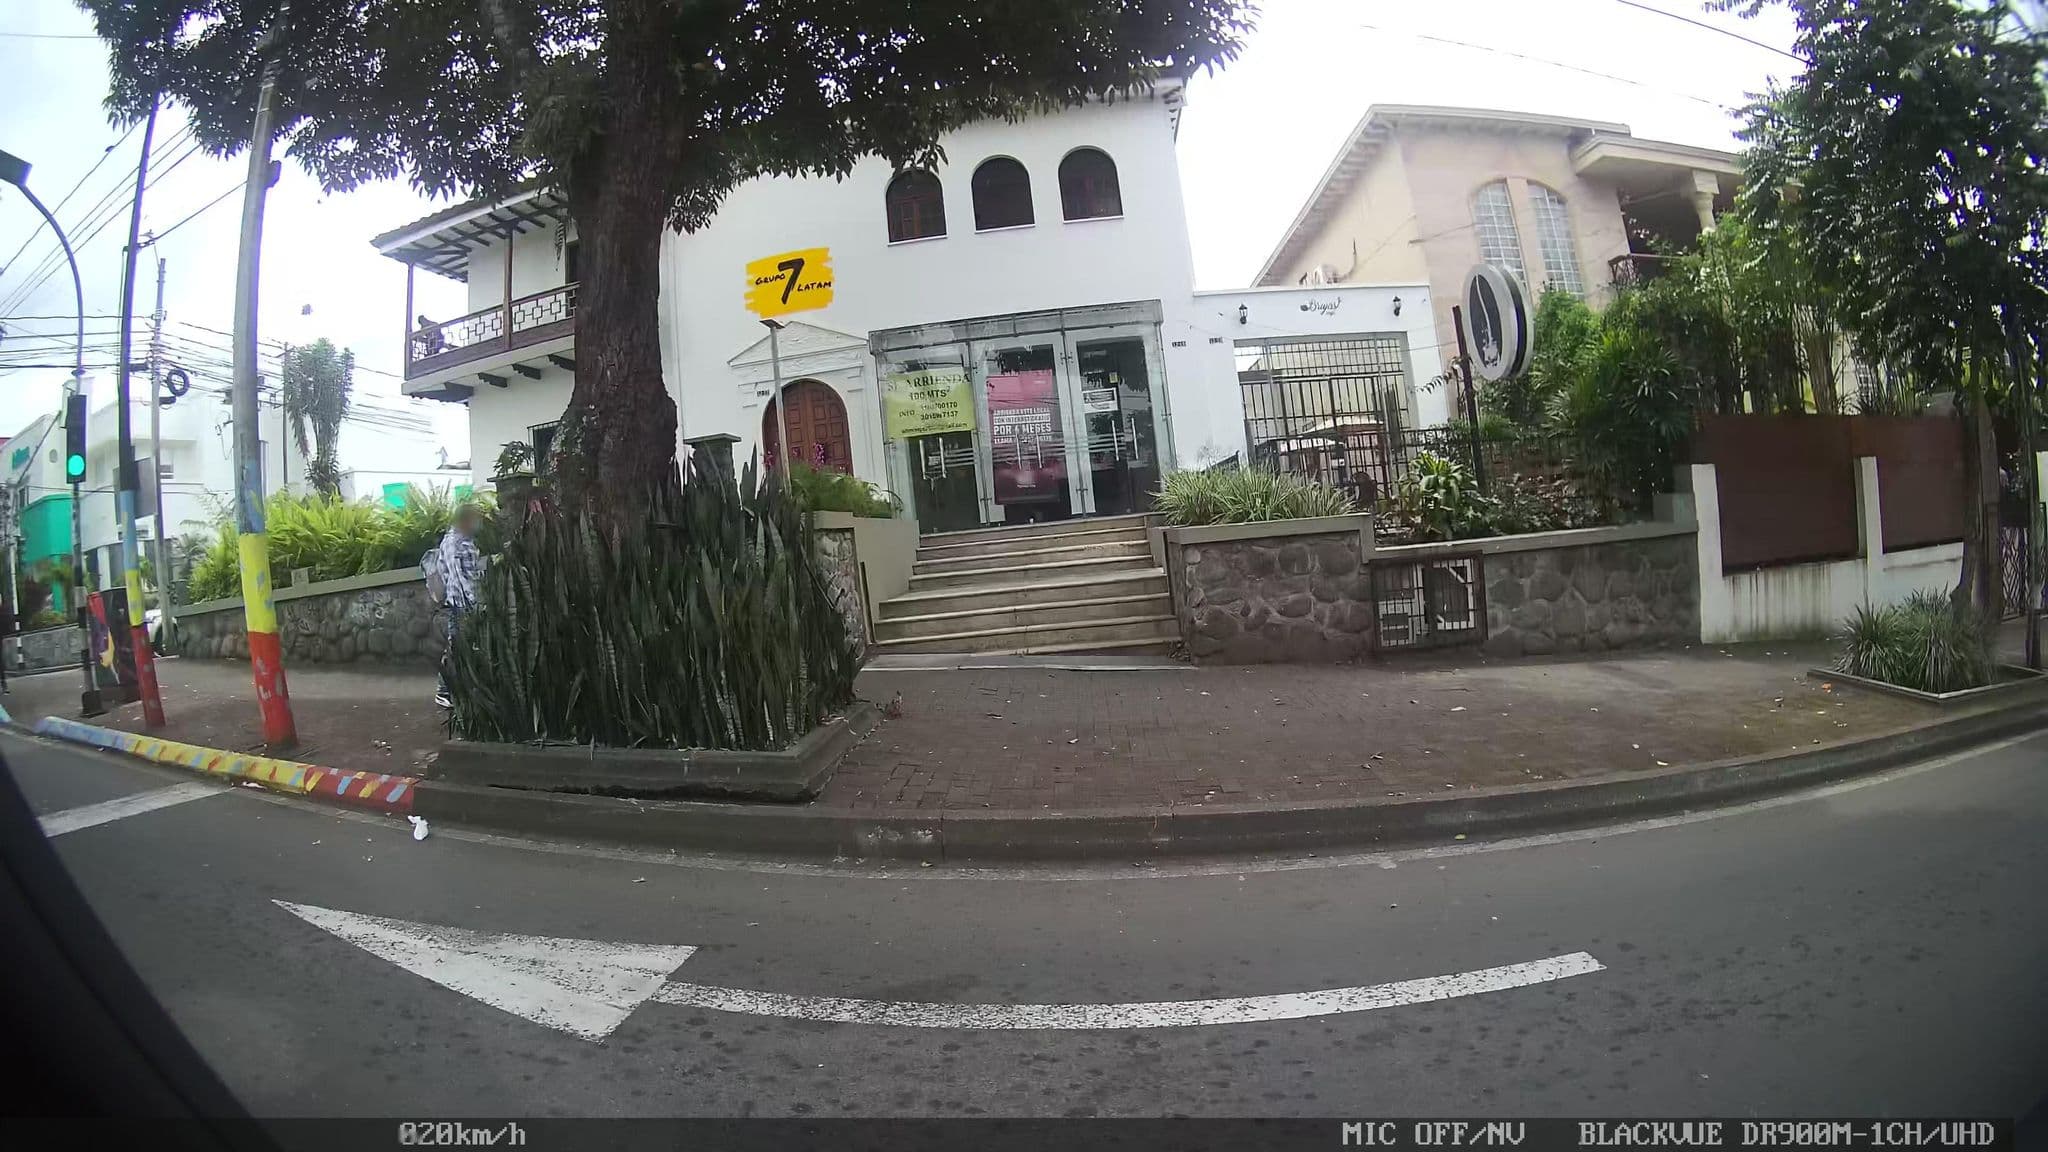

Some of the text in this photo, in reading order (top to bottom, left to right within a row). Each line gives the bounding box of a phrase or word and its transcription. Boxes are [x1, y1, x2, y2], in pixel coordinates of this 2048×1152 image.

[755, 258, 831, 304] GRUPO 7 LATAM
[993, 425, 1012, 435] POR
